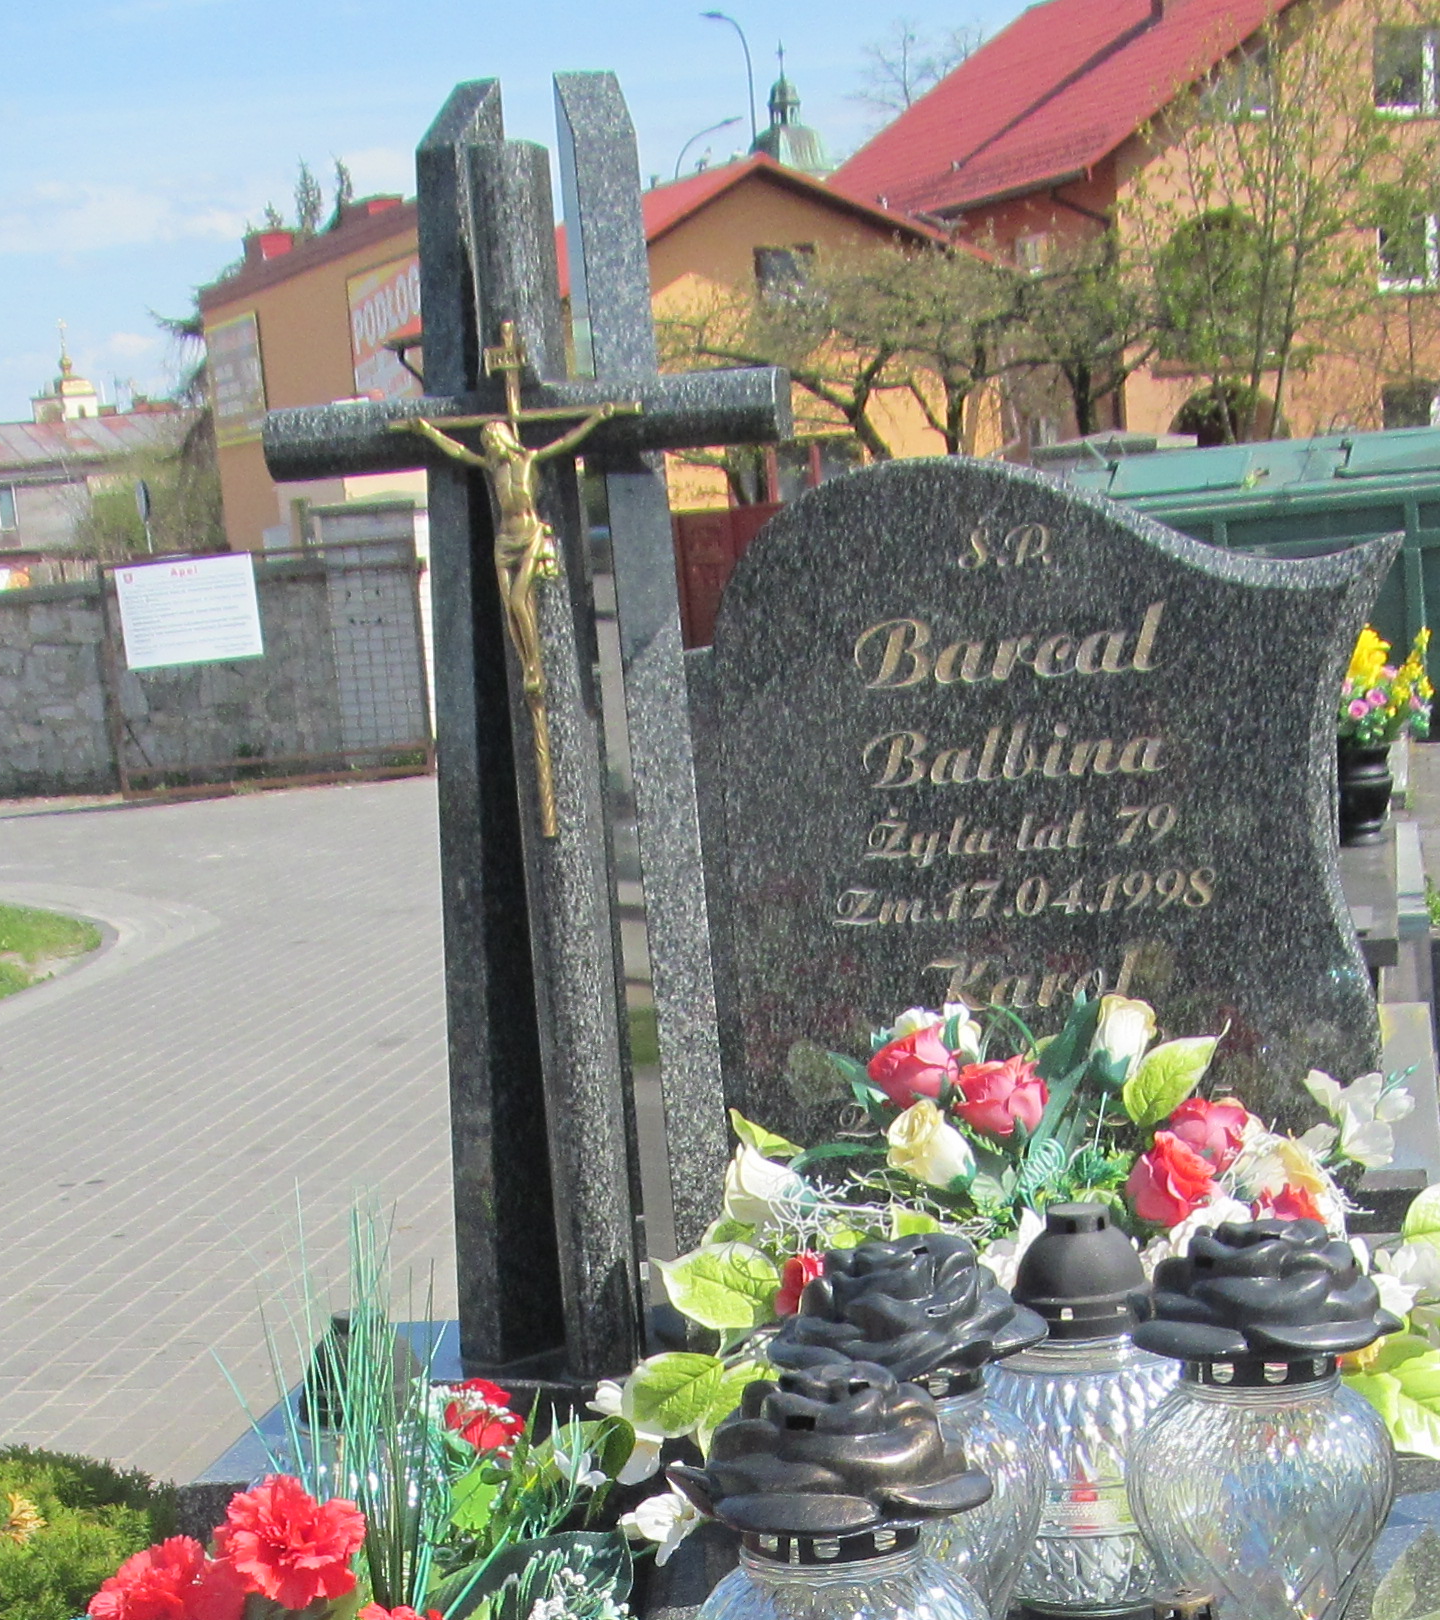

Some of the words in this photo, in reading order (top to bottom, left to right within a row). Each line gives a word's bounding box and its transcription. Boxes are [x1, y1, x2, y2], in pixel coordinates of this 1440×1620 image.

[170, 565, 198, 578] Apel
[862, 722, 1166, 789] Balbina
[1016, 808, 1090, 852] lat
[1115, 803, 1177, 846] 79
